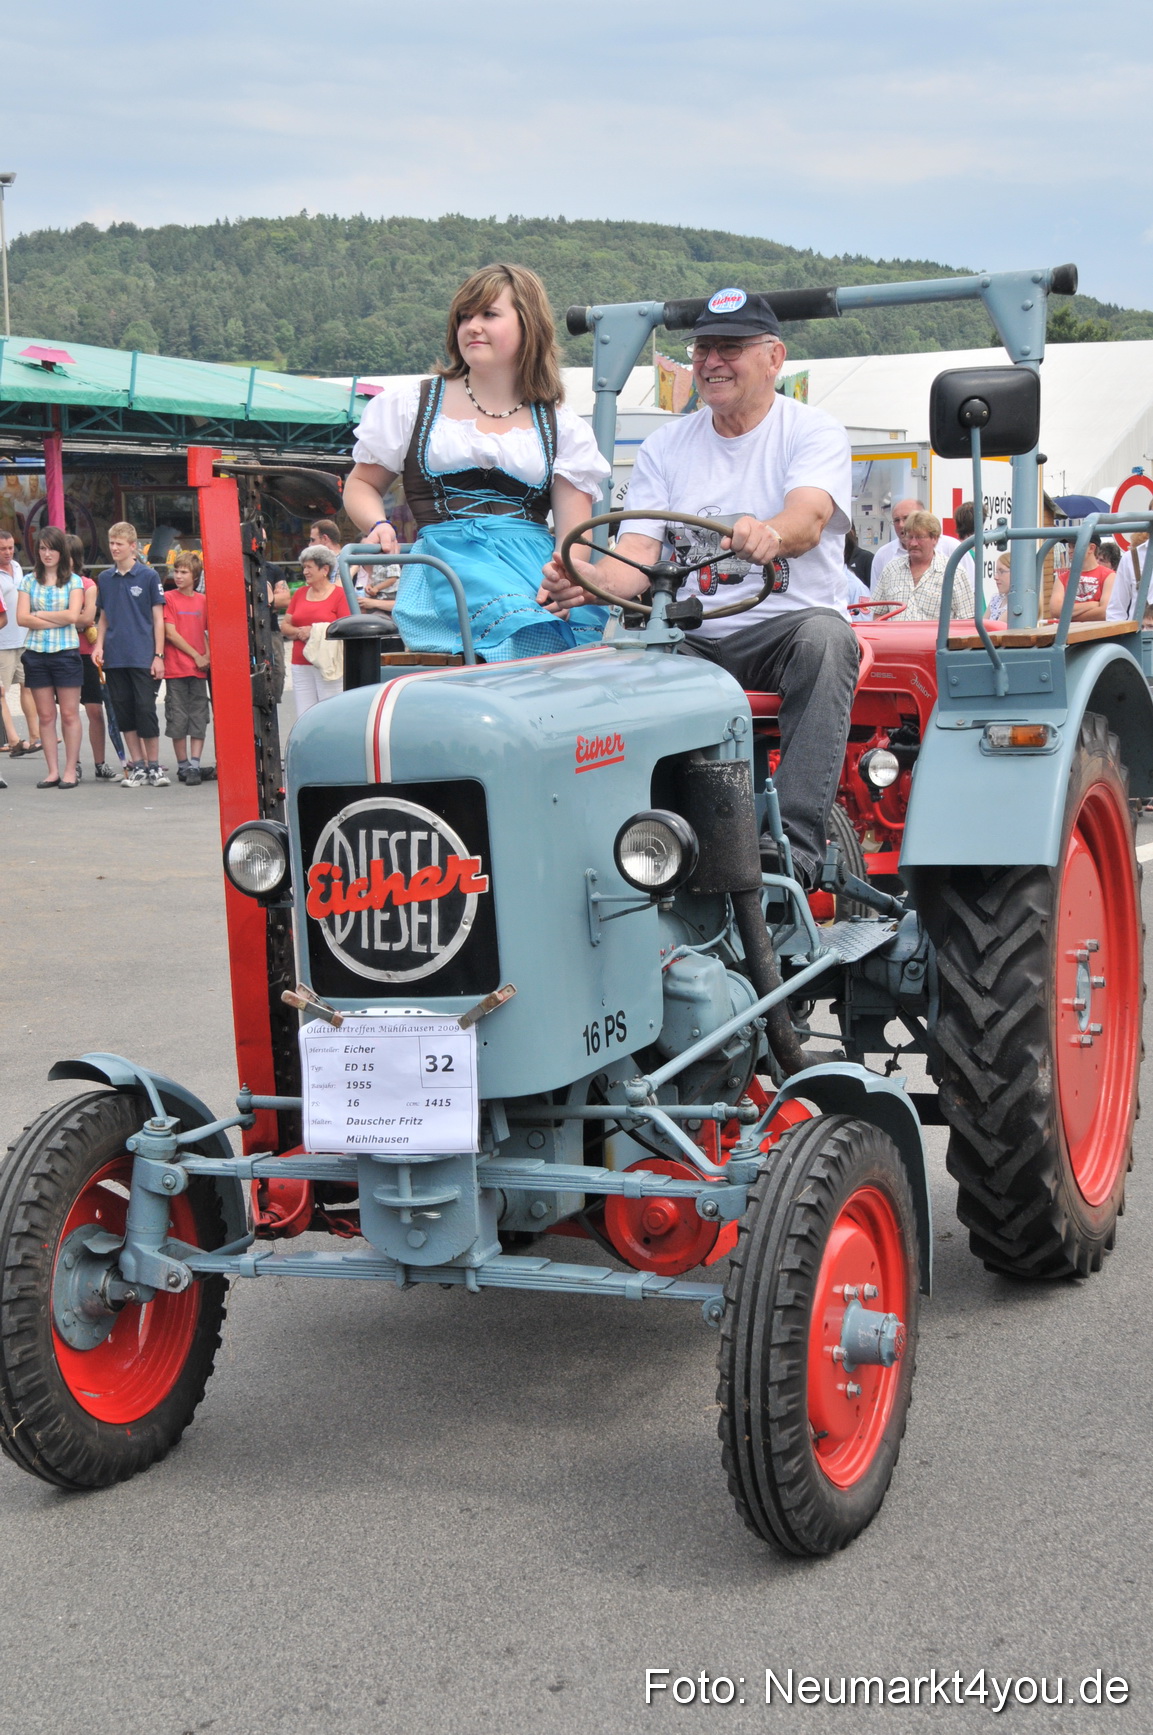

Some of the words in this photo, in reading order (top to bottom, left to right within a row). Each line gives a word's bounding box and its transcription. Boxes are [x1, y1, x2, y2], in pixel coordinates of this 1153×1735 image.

[711, 295, 743, 307] Eicher
[983, 491, 1012, 520] ayeris
[910, 671, 932, 698] Junior
[575, 732, 625, 764] Eicher
[306, 855, 489, 920] Eicher
[333, 828, 448, 954] DIESEL
[306, 1023, 376, 1035] Oldtimertreffen
[378, 1022, 435, 1034] Mühlhausen
[437, 1025, 460, 1033] 2009
[582, 1020, 601, 1057] 16
[604, 1009, 628, 1048] PS
[344, 1045, 375, 1054] Eicher
[344, 1063, 358, 1072] ED
[361, 1063, 374, 1072] 15
[425, 1054, 455, 1073] 32
[346, 1080, 372, 1089] 1955
[347, 1098, 360, 1107] 16
[424, 1098, 452, 1107] 1415
[346, 1116, 397, 1126] Dauscher
[398, 1116, 424, 1126] Fritz
[345, 1134, 410, 1144] Mühlhausen
